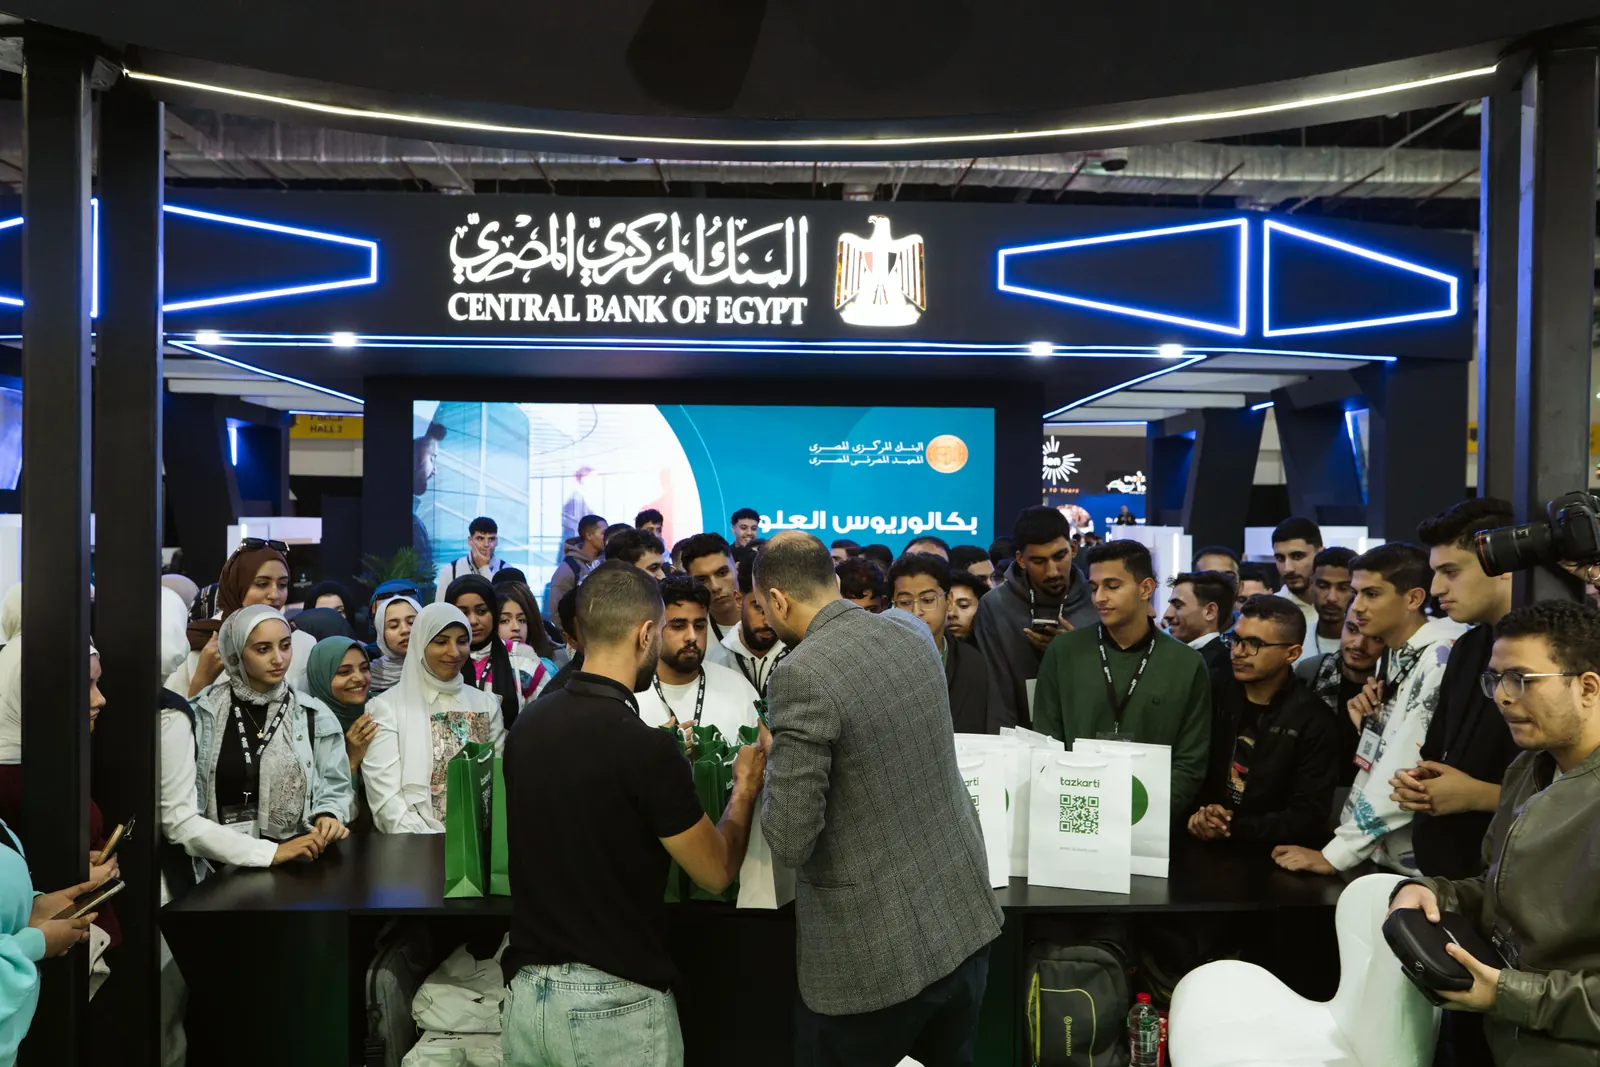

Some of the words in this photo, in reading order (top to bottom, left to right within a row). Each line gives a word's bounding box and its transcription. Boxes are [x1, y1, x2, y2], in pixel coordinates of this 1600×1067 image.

[686, 213, 809, 289] البنك
[448, 292, 581, 322] CENTRAL
[585, 294, 668, 323] BANK
[672, 295, 711, 324] OF
[716, 296, 808, 325] EGYPT
[894, 441, 924, 453] البنك
[758, 510, 826, 533] العلو
[832, 511, 978, 535] بكالوريوس
[1060, 776, 1100, 788] tazkarti
